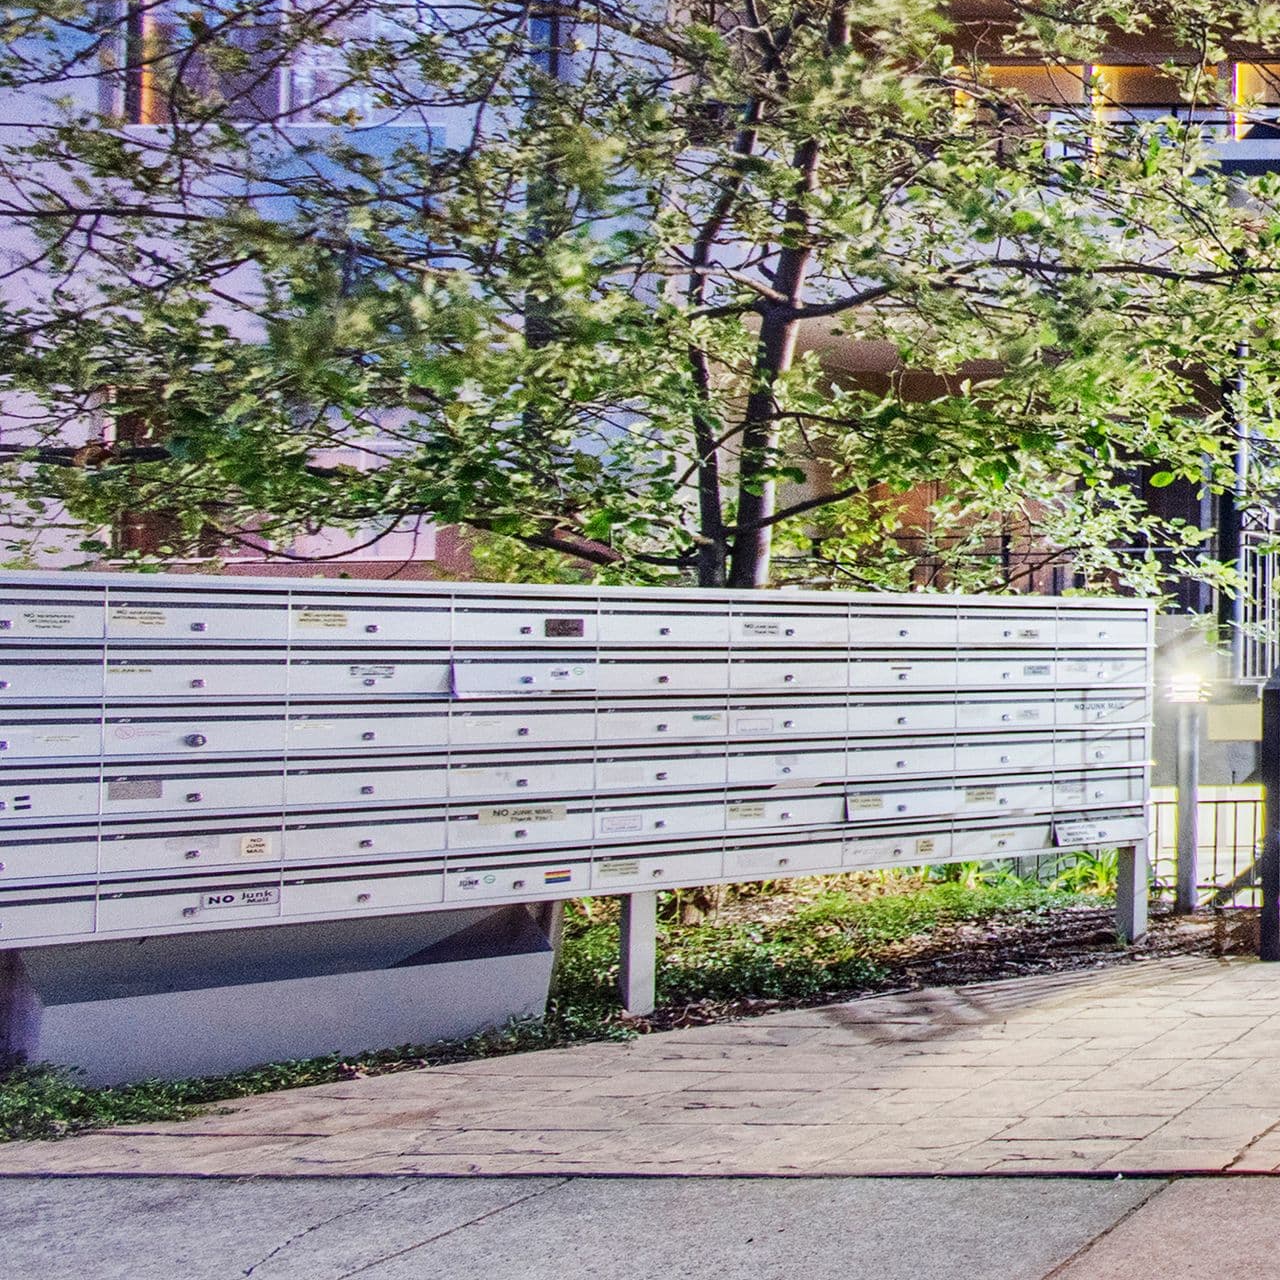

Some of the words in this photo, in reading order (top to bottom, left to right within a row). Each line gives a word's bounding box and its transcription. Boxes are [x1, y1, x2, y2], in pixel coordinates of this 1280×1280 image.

[492, 809, 509, 817] NO
[208, 895, 235, 904] NO
[241, 889, 273, 900] Junk
